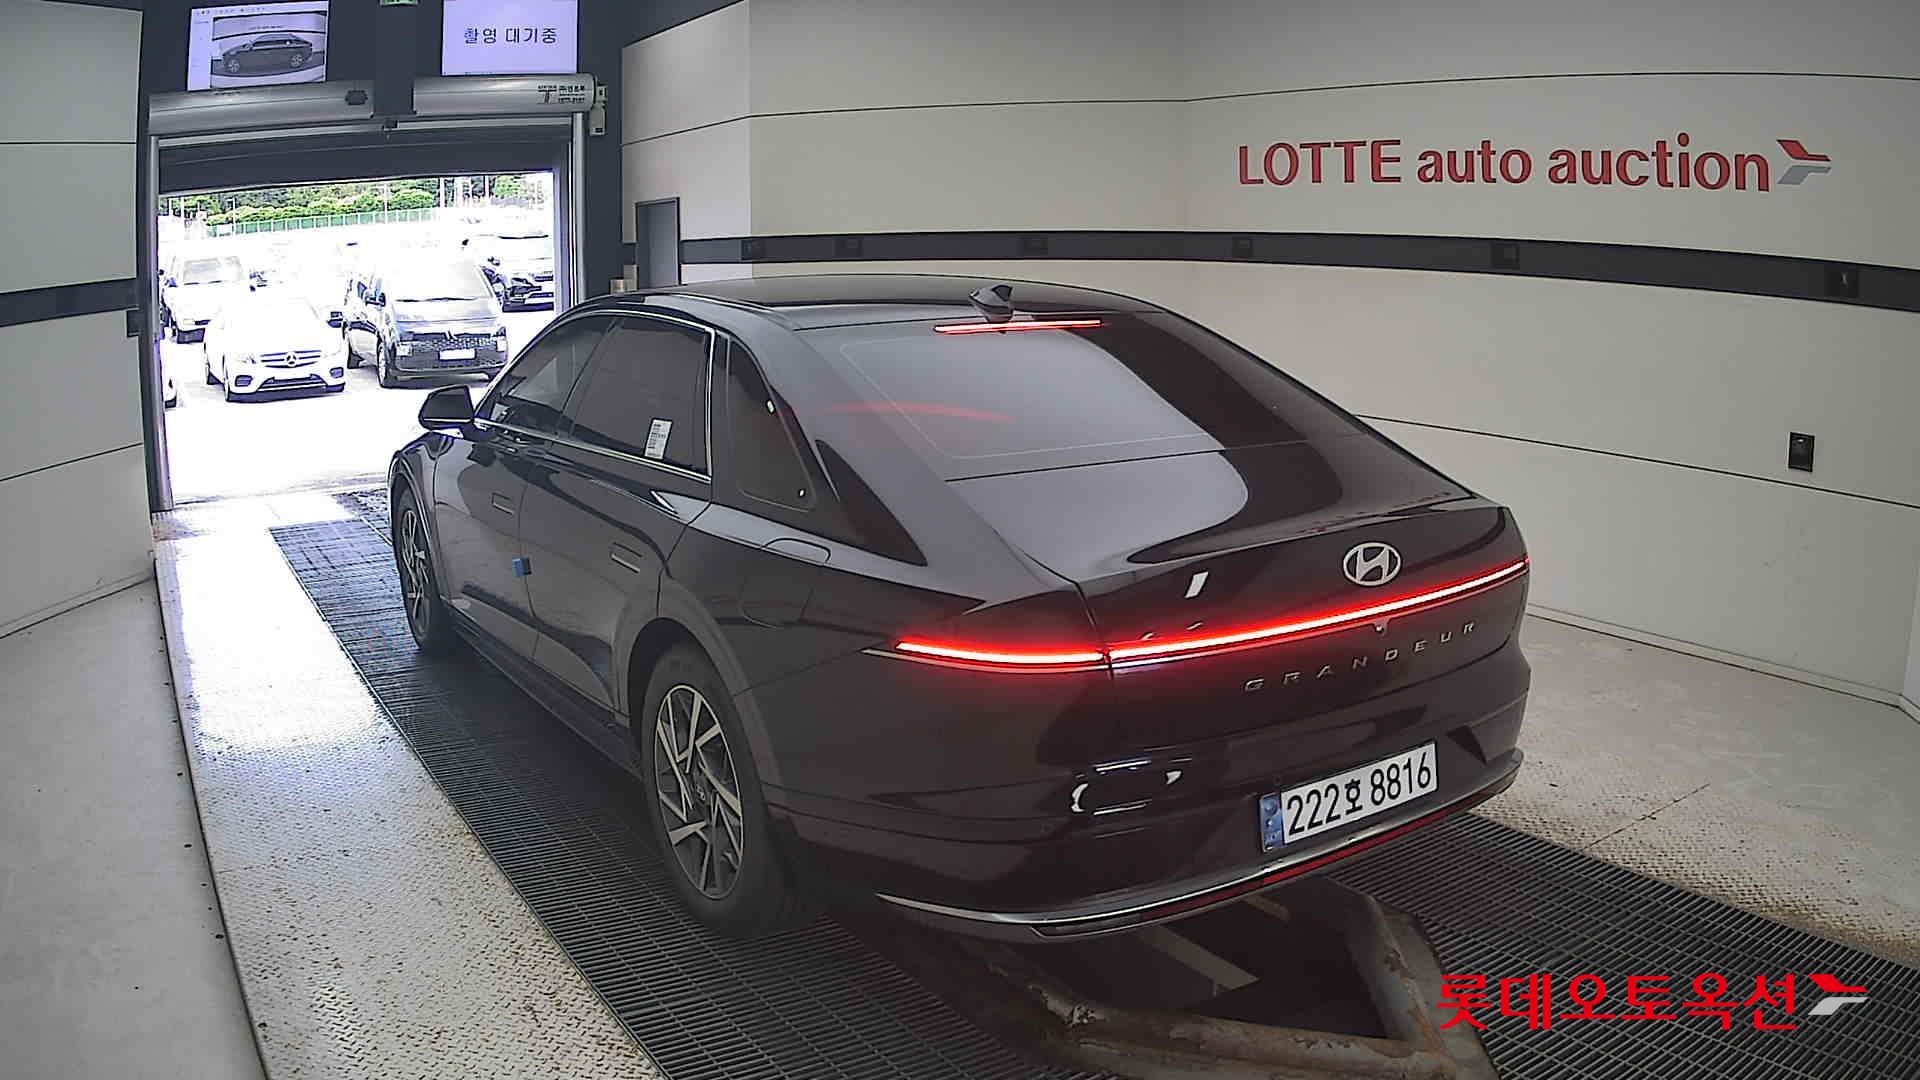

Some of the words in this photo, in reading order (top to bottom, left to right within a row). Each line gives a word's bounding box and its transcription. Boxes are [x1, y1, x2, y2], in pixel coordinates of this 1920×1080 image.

[464, 28, 497, 44] 촬영
[505, 28, 557, 44] 대기중
[1238, 138, 1402, 186] LOTTE
[1416, 139, 1533, 184] auto
[1548, 132, 1770, 193] auction
[1243, 621, 1475, 693] GRANDEUR
[1286, 778, 1363, 837] 222호
[1370, 751, 1431, 807] 8816
